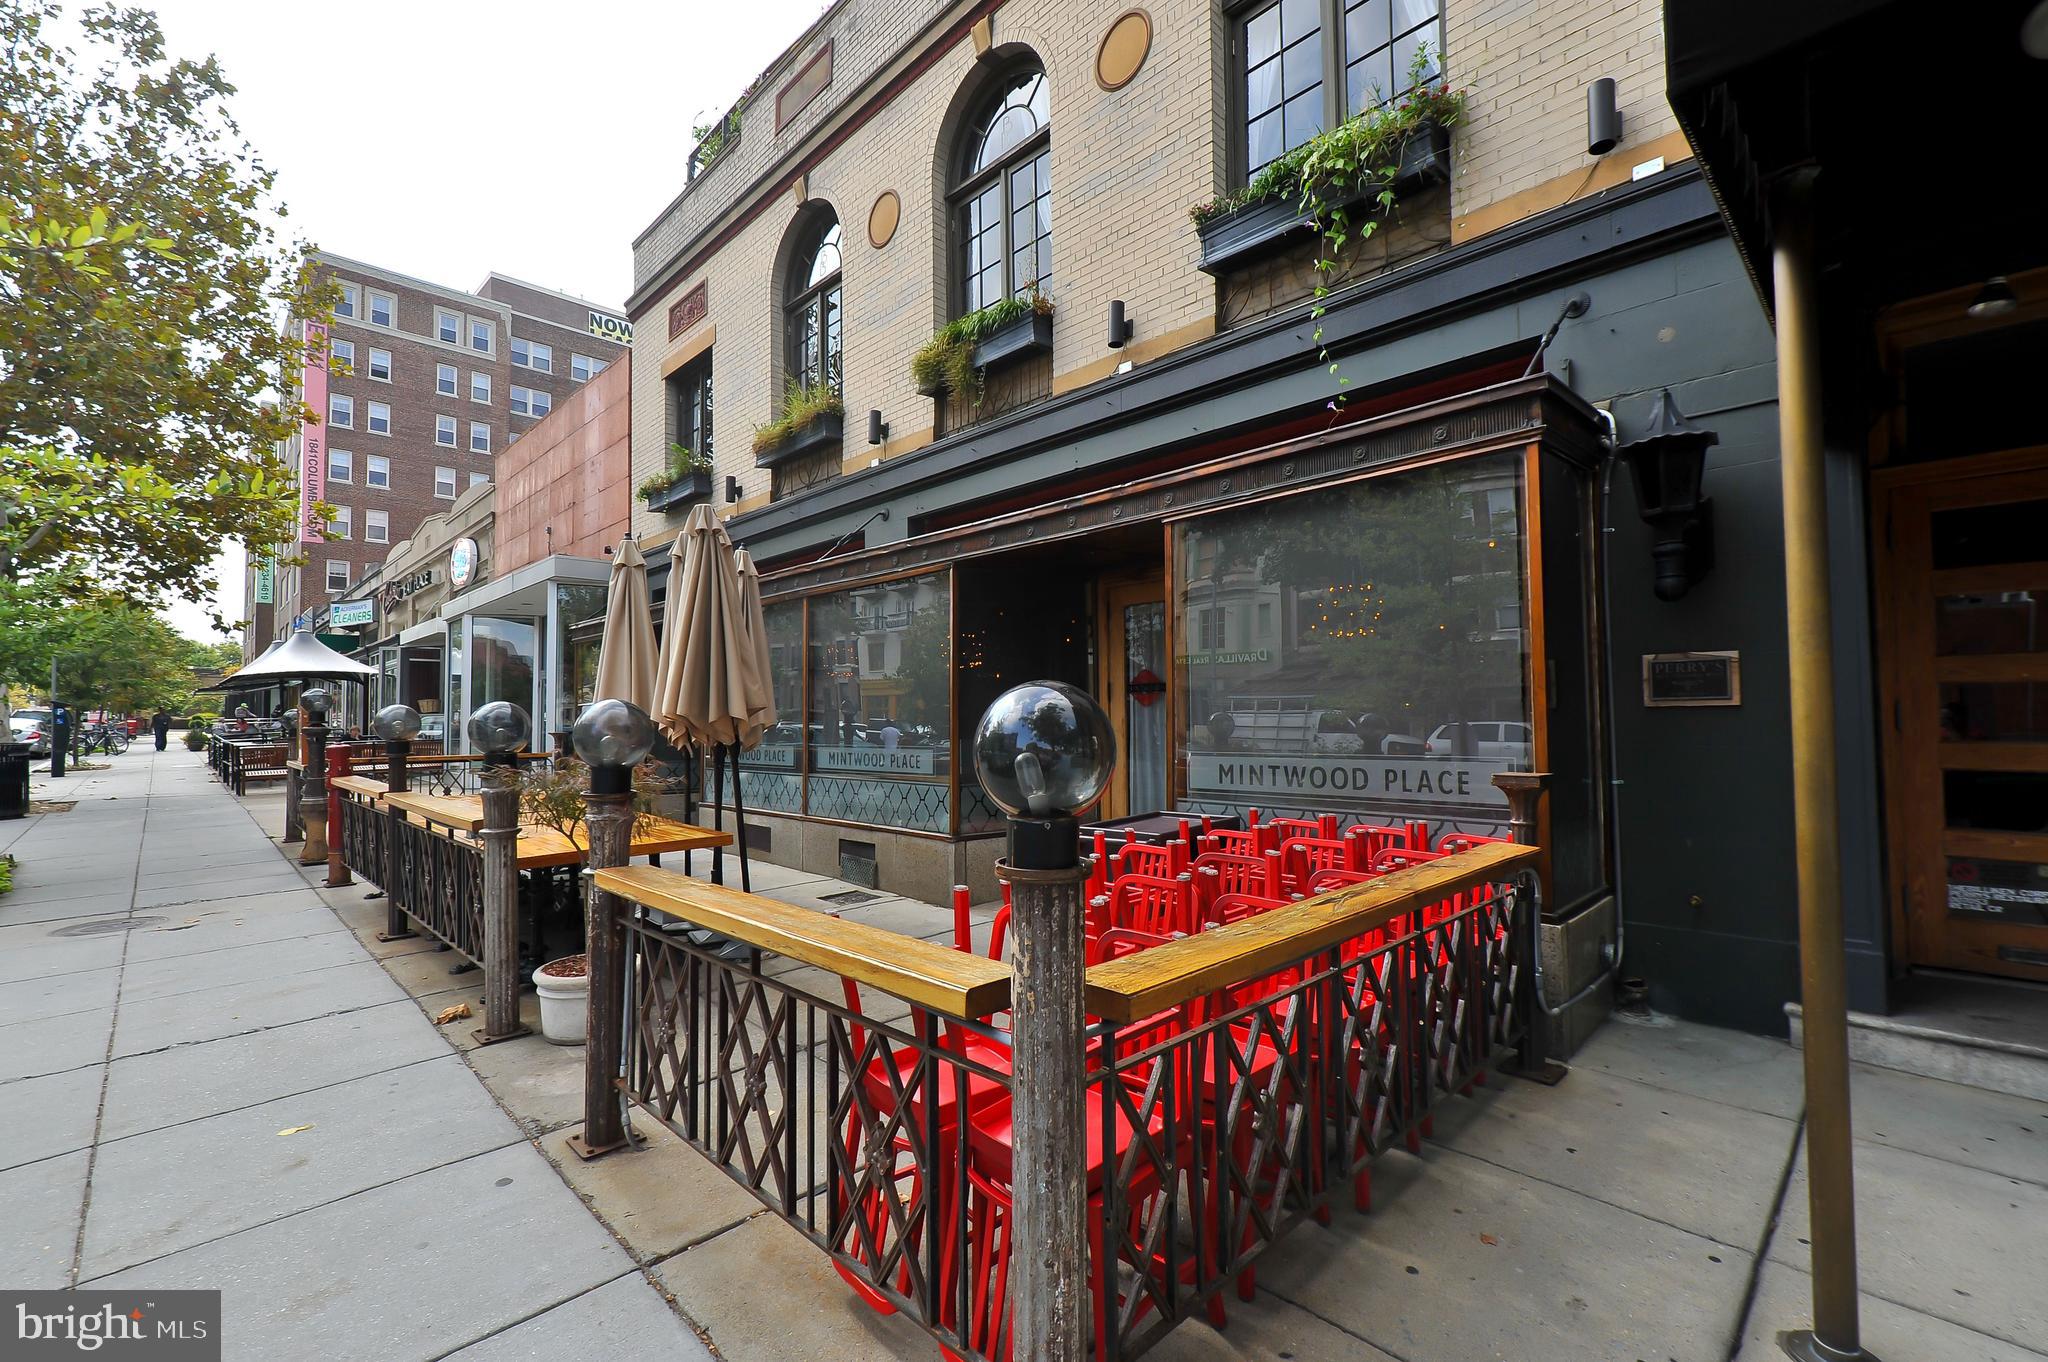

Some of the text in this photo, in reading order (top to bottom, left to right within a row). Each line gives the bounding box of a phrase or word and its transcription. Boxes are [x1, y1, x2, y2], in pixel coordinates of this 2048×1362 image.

[590, 313, 633, 339] NOW
[333, 610, 372, 624] CLEANERS
[764, 749, 785, 762] PLACE
[828, 751, 921, 769] MINTWOOD PLACE
[1218, 763, 1470, 796] MINTWOOD PLACE
